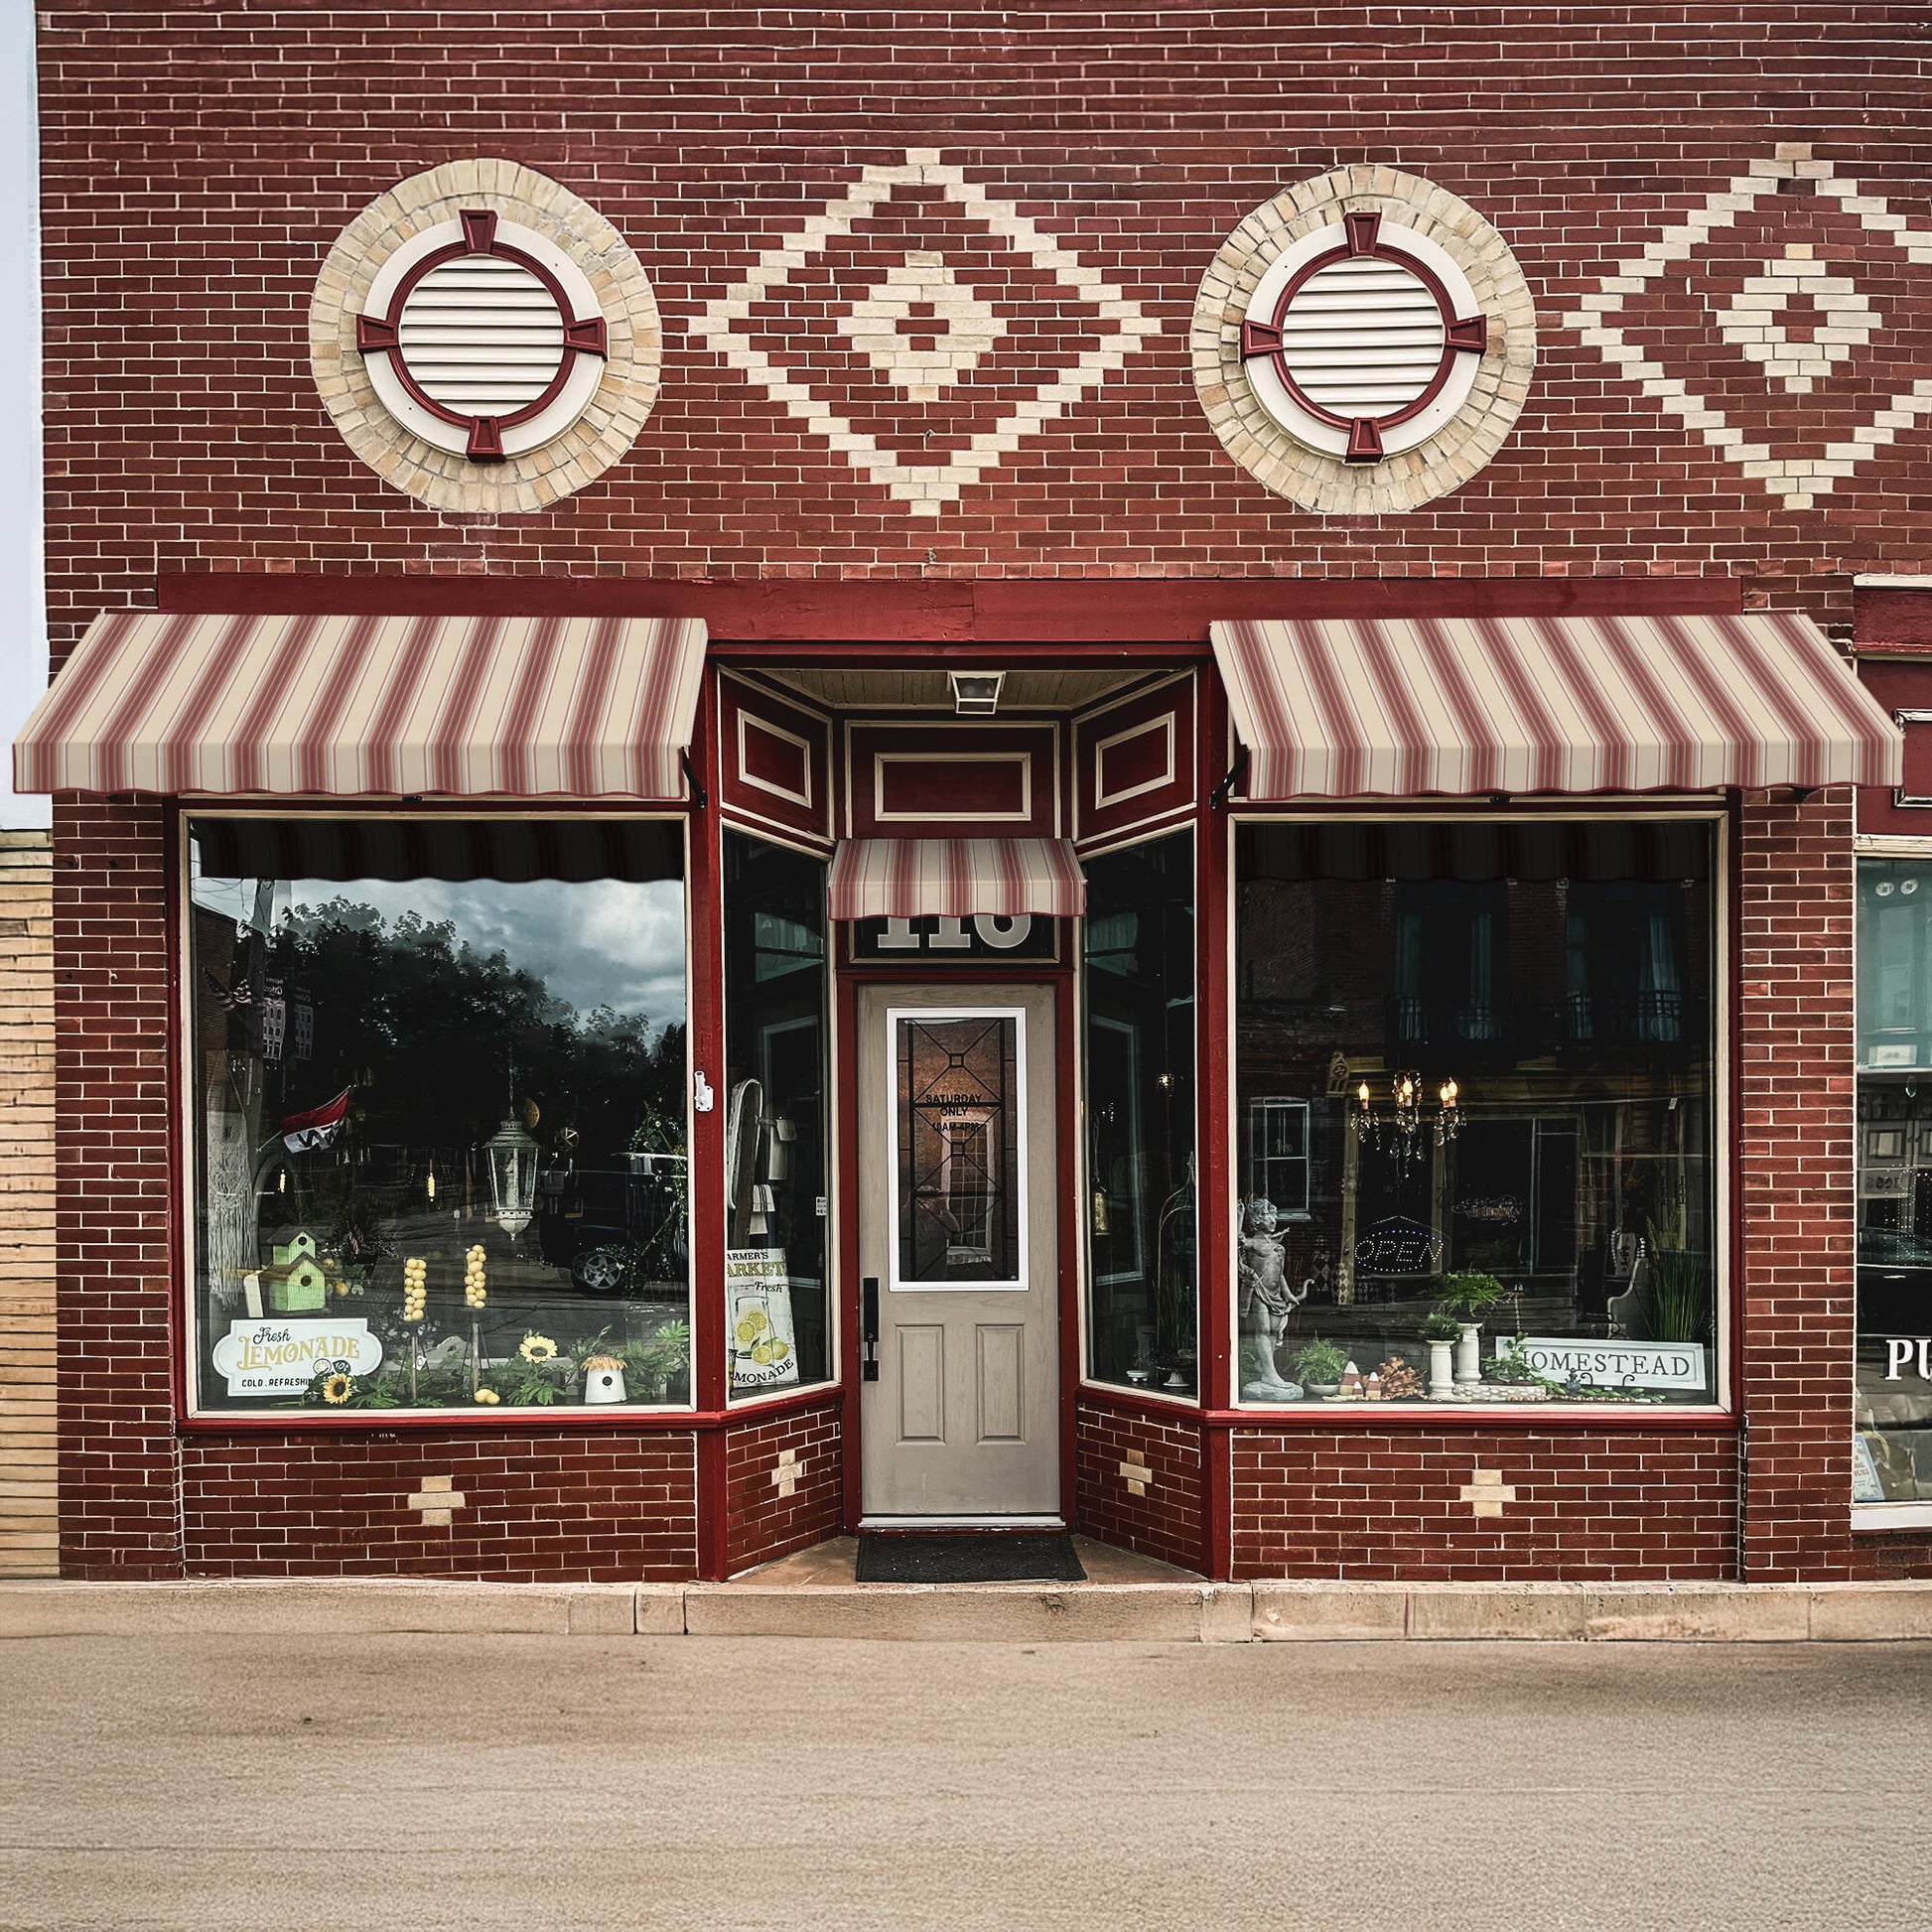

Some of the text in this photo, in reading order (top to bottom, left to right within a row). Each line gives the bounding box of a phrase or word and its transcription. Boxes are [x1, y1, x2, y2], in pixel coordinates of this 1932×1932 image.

[925, 1093, 982, 1104] SATURDAY
[940, 1106, 969, 1117] ONLY
[1354, 1239, 1445, 1264] OPEN
[754, 1281, 783, 1294] Fresh
[253, 1326, 291, 1344] Fresh
[237, 1336, 359, 1370] LEMONADE
